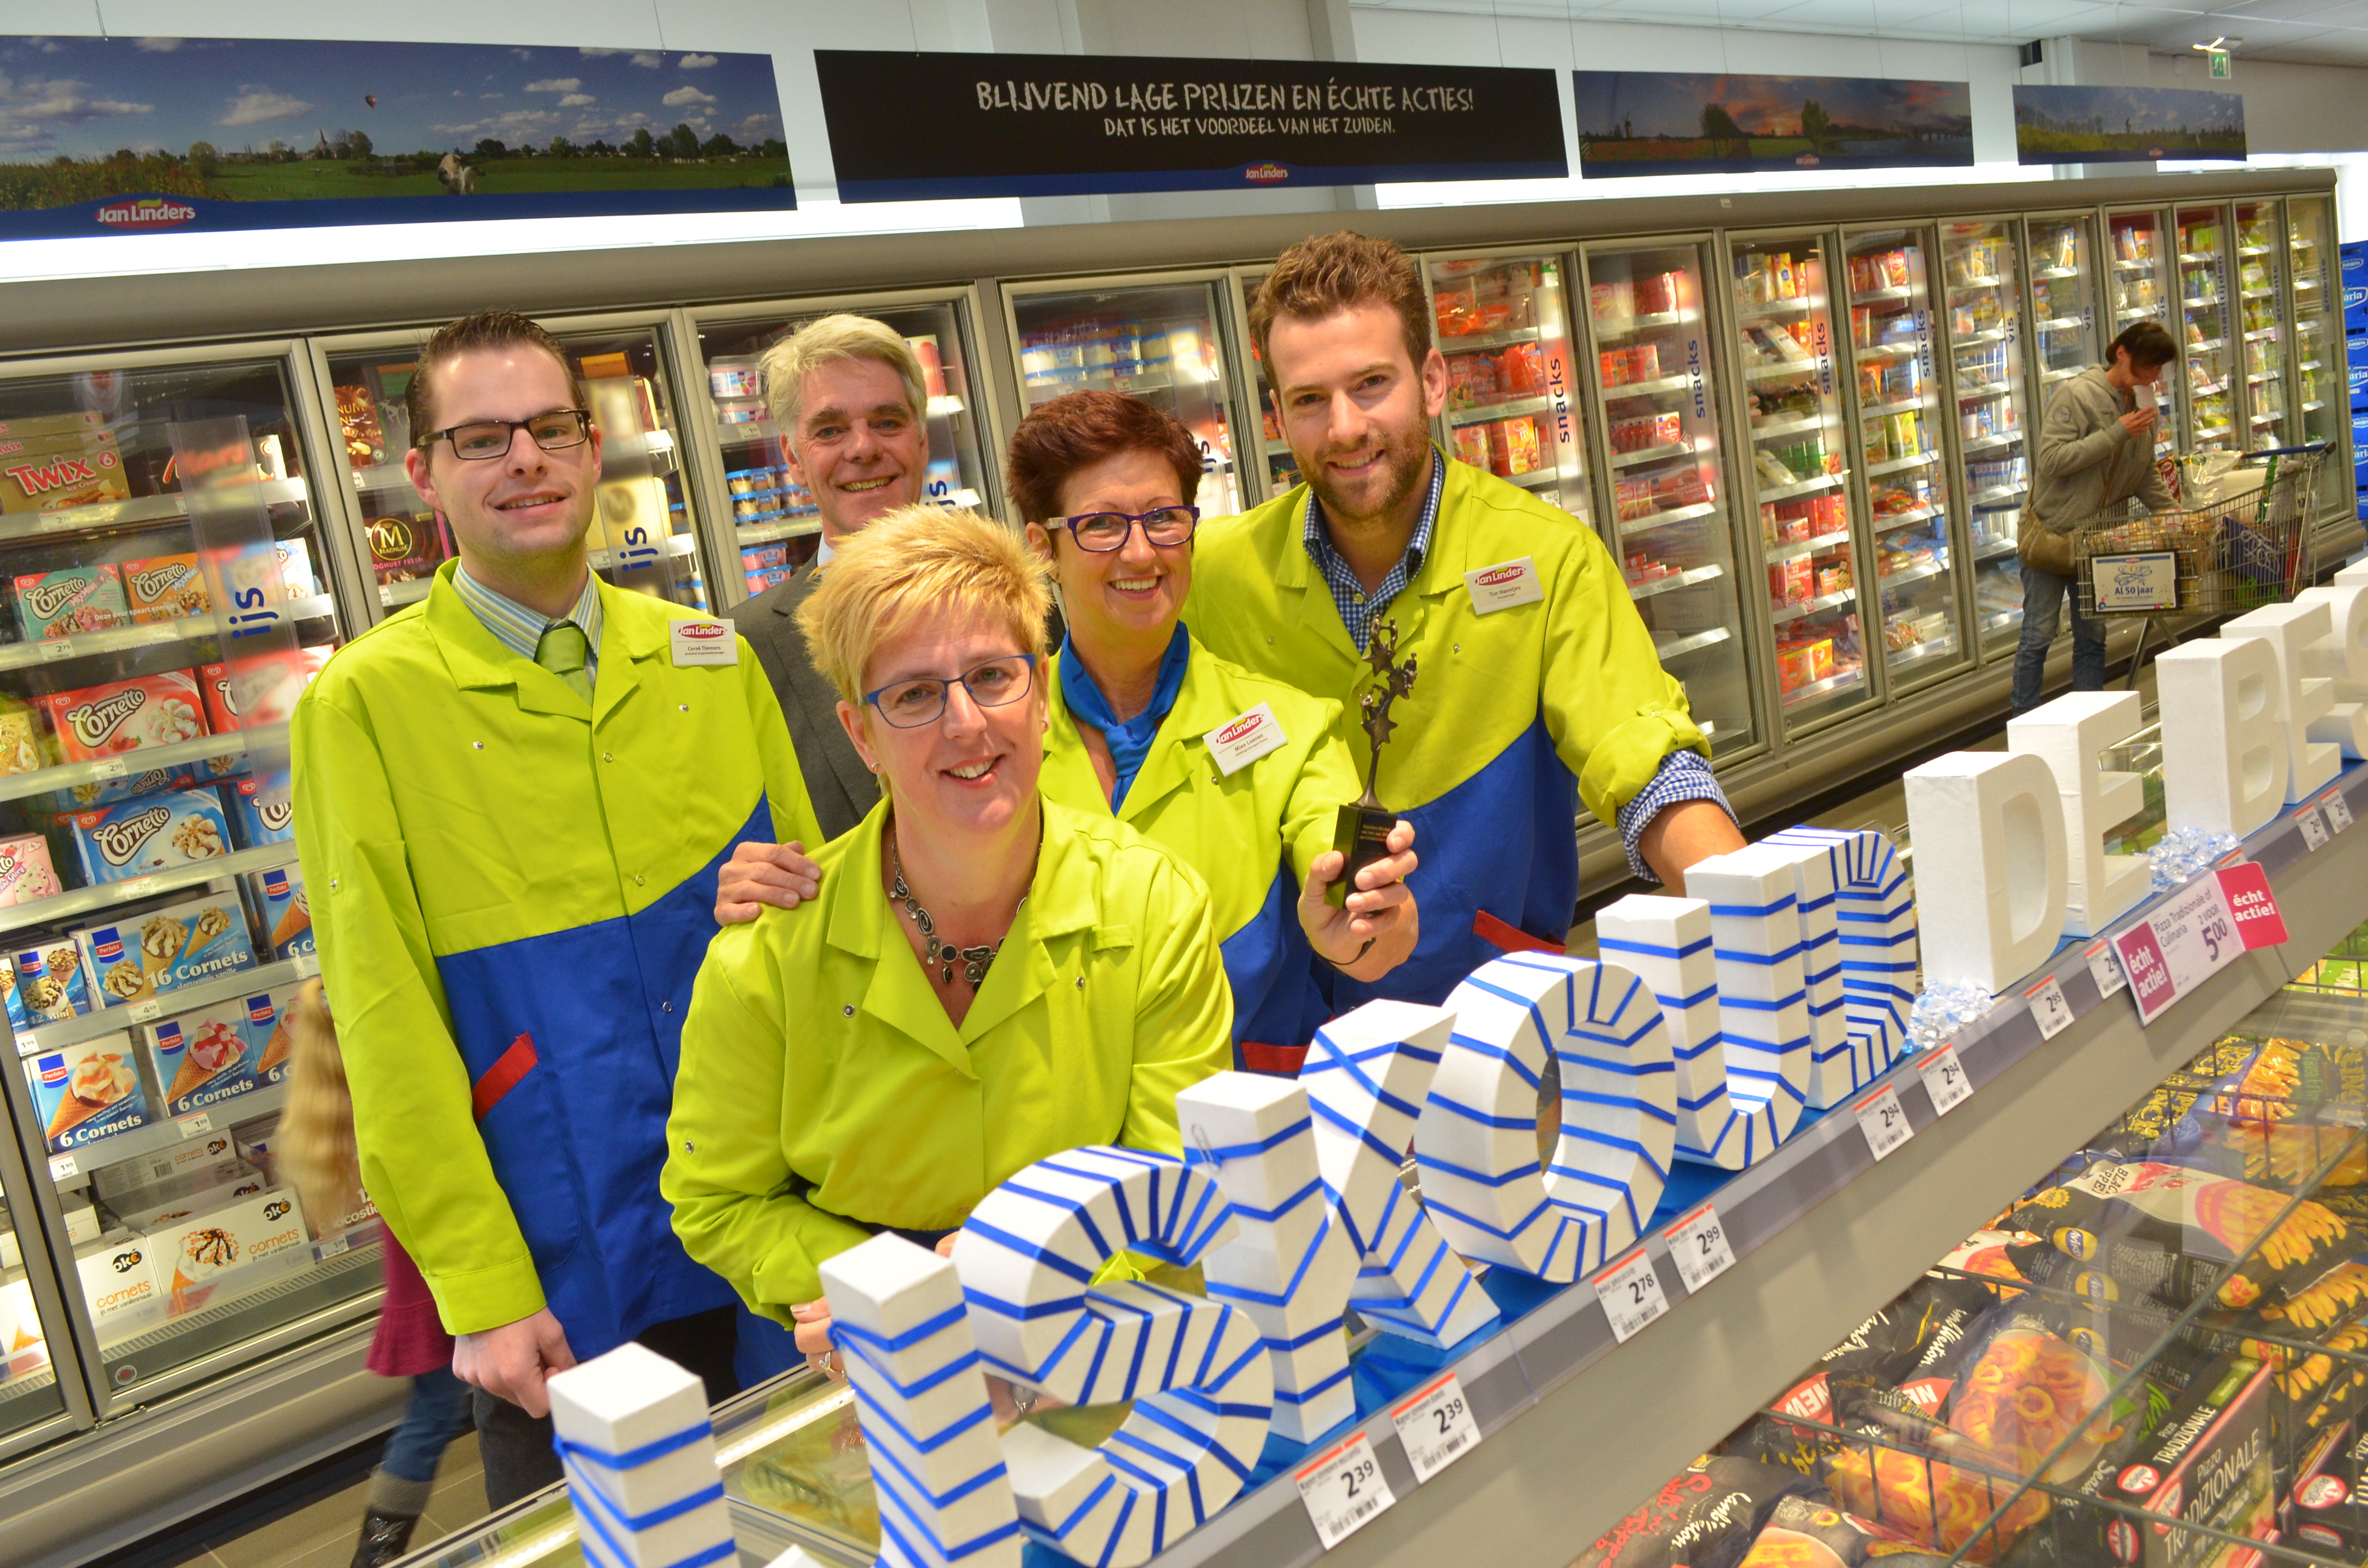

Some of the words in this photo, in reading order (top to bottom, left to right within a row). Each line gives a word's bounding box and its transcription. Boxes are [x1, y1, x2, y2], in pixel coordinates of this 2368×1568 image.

[976, 81, 1107, 111] BLIJVEND
[1116, 83, 1178, 112] LAGE
[1184, 83, 1284, 111] PRIJZEN
[1292, 85, 1320, 110] EN
[1327, 77, 1395, 110] ÉCHTE
[1402, 87, 1473, 112] ACTIES!
[1105, 118, 1135, 136] DAT
[1141, 118, 1157, 136] IS
[1161, 118, 1190, 135] HET
[1195, 118, 1275, 135] VOORDEEL
[1278, 118, 1308, 135] VAN
[1313, 118, 1339, 134] HET
[1344, 117, 1395, 134] ZUIDEN.
[1246, 168, 1259, 179] Jan
[1260, 166, 1288, 179] Linders
[97, 208, 129, 223] Jan
[131, 204, 196, 221] Linders
[1913, 309, 1931, 378] snacks
[1815, 322, 1832, 395] snacks
[1688, 339, 1705, 419] snacks
[1550, 358, 1570, 443] snacks
[5, 455, 96, 496] Twix
[79, 479, 100, 490] Cream
[379, 545, 408, 556] MAGNUM
[619, 527, 658, 571] ijs
[373, 560, 402, 570] OGHURT
[403, 556, 424, 566] FRESH
[131, 563, 187, 603] Cornetto
[1476, 576, 1492, 585] Jan
[1492, 567, 1526, 581] Linders
[25, 577, 86, 621] Cornetto
[2137, 586, 2154, 595] jaar
[129, 608, 150, 616] spaart
[229, 588, 279, 638] ijs
[695, 626, 727, 635] Linders
[66, 689, 146, 748] Cornetto
[1216, 731, 1233, 744] Jan
[1232, 714, 1265, 736] Linders
[1235, 743, 1246, 752] Mien
[91, 806, 171, 868] Cornetto
[270, 885, 286, 893] Perfekt
[2233, 890, 2266, 907] écht
[2154, 919, 2171, 935] Pizza
[2170, 895, 2206, 923] Tradizionale
[2197, 915, 2204, 925] 2
[2203, 904, 2220, 922] VOOR
[2234, 903, 2275, 922] actie!
[2160, 924, 2188, 947] Culinaria
[99, 945, 120, 954] Perfekt
[288, 942, 299, 956] 6
[2128, 946, 2154, 975] écht
[147, 968, 172, 989] 16
[176, 950, 248, 980] Cornets
[2138, 963, 2168, 999] actie!
[254, 1009, 271, 1017] Perfekt
[2046, 991, 2062, 1013] 295
[47, 1008, 69, 1021] Mini
[162, 1038, 181, 1046] Perfekt
[45, 1070, 64, 1080] Perfekt
[269, 1066, 281, 1081] 6
[1942, 1062, 1960, 1085] 294
[178, 1096, 190, 1111] 6
[193, 1079, 253, 1106] Cornets
[1880, 1103, 1899, 1128] 294
[60, 1131, 73, 1147] 6
[76, 1114, 142, 1141] Cornets
[175, 1147, 203, 1162] cornets
[264, 1198, 291, 1221] oké
[249, 1228, 299, 1255] cornets
[1697, 1225, 1720, 1256] 299
[113, 1248, 140, 1272] oké
[97, 1280, 150, 1309] cornets
[1629, 1273, 1654, 1305] 278
[107, 1304, 119, 1313] met
[1785, 1380, 1831, 1417] NEW
[1433, 1398, 1463, 1434] 239
[2153, 1405, 2216, 1464] TRADIZIONALE
[2197, 1448, 2221, 1483] Pizza
[1341, 1459, 1374, 1499] 239
